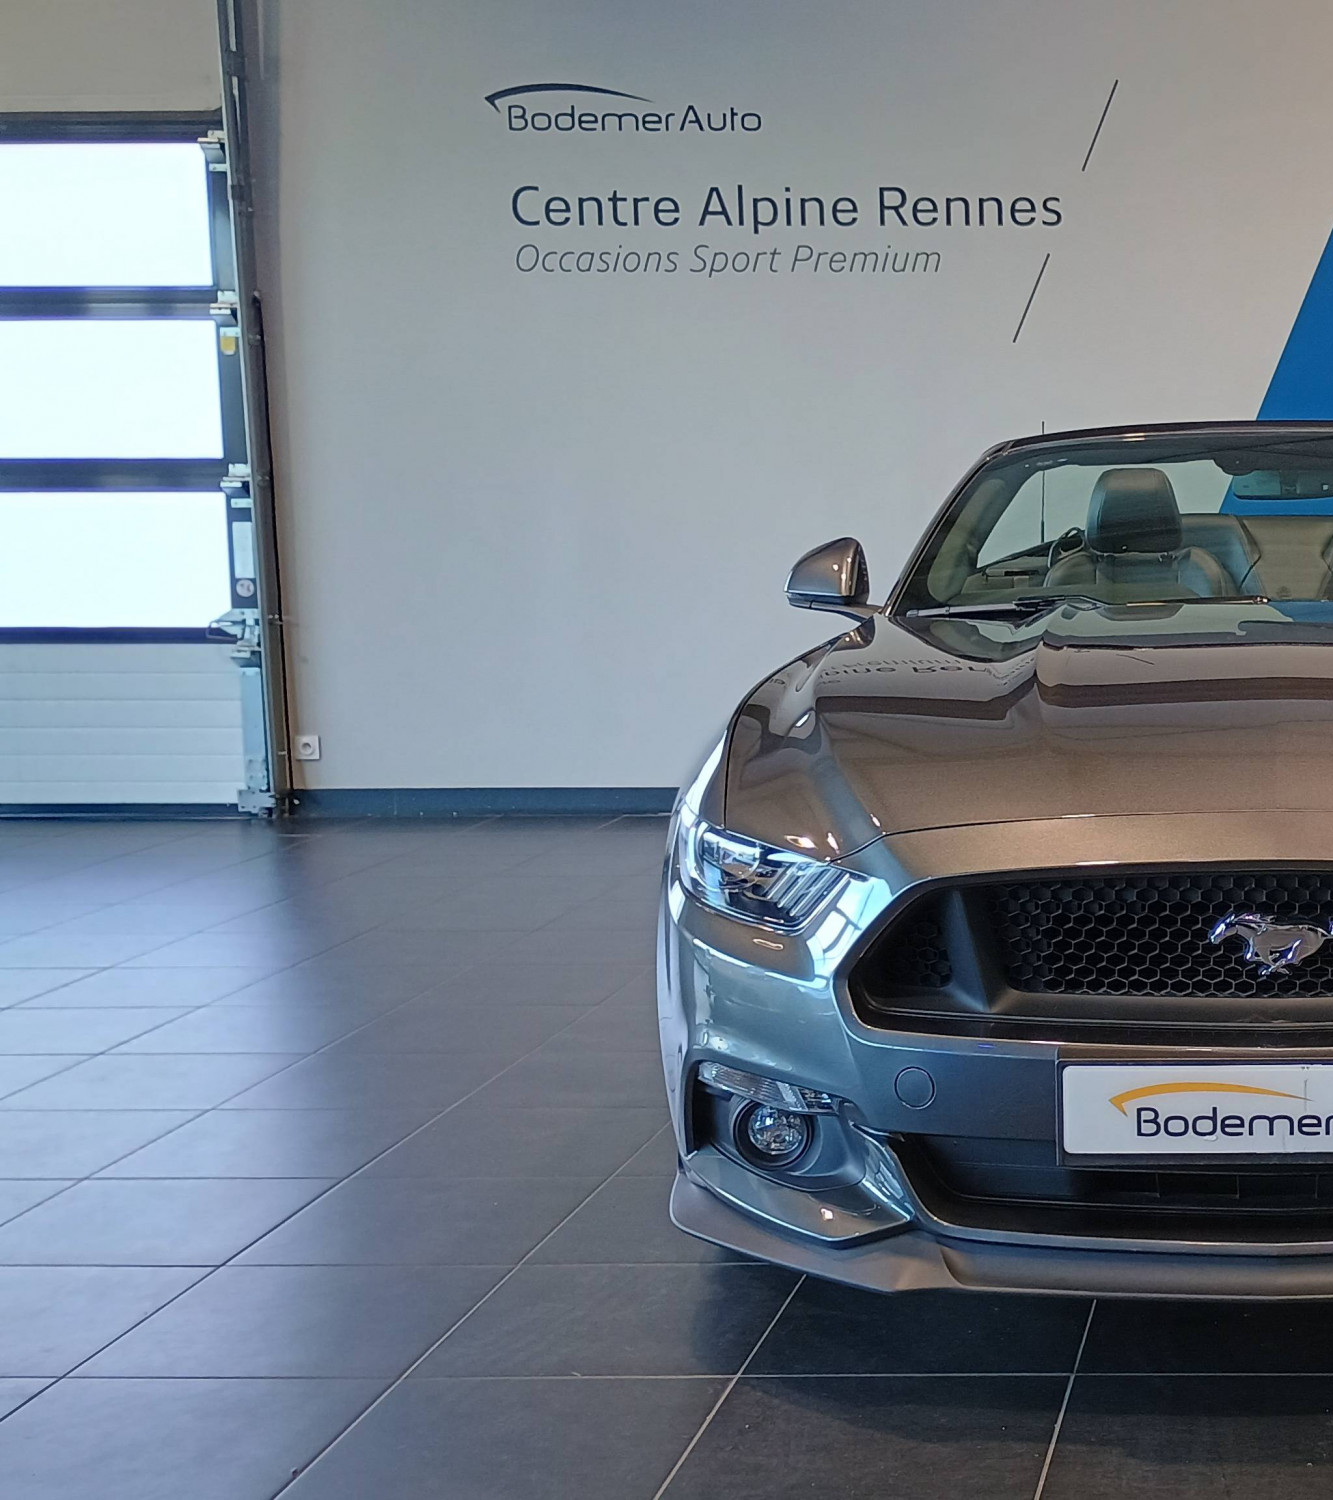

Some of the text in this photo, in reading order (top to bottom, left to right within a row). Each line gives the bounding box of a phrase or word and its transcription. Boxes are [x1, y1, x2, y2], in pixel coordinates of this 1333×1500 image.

[511, 184, 1063, 233] Centre Alpine Rennes
[516, 243, 941, 278] Occasions Sport Premium
